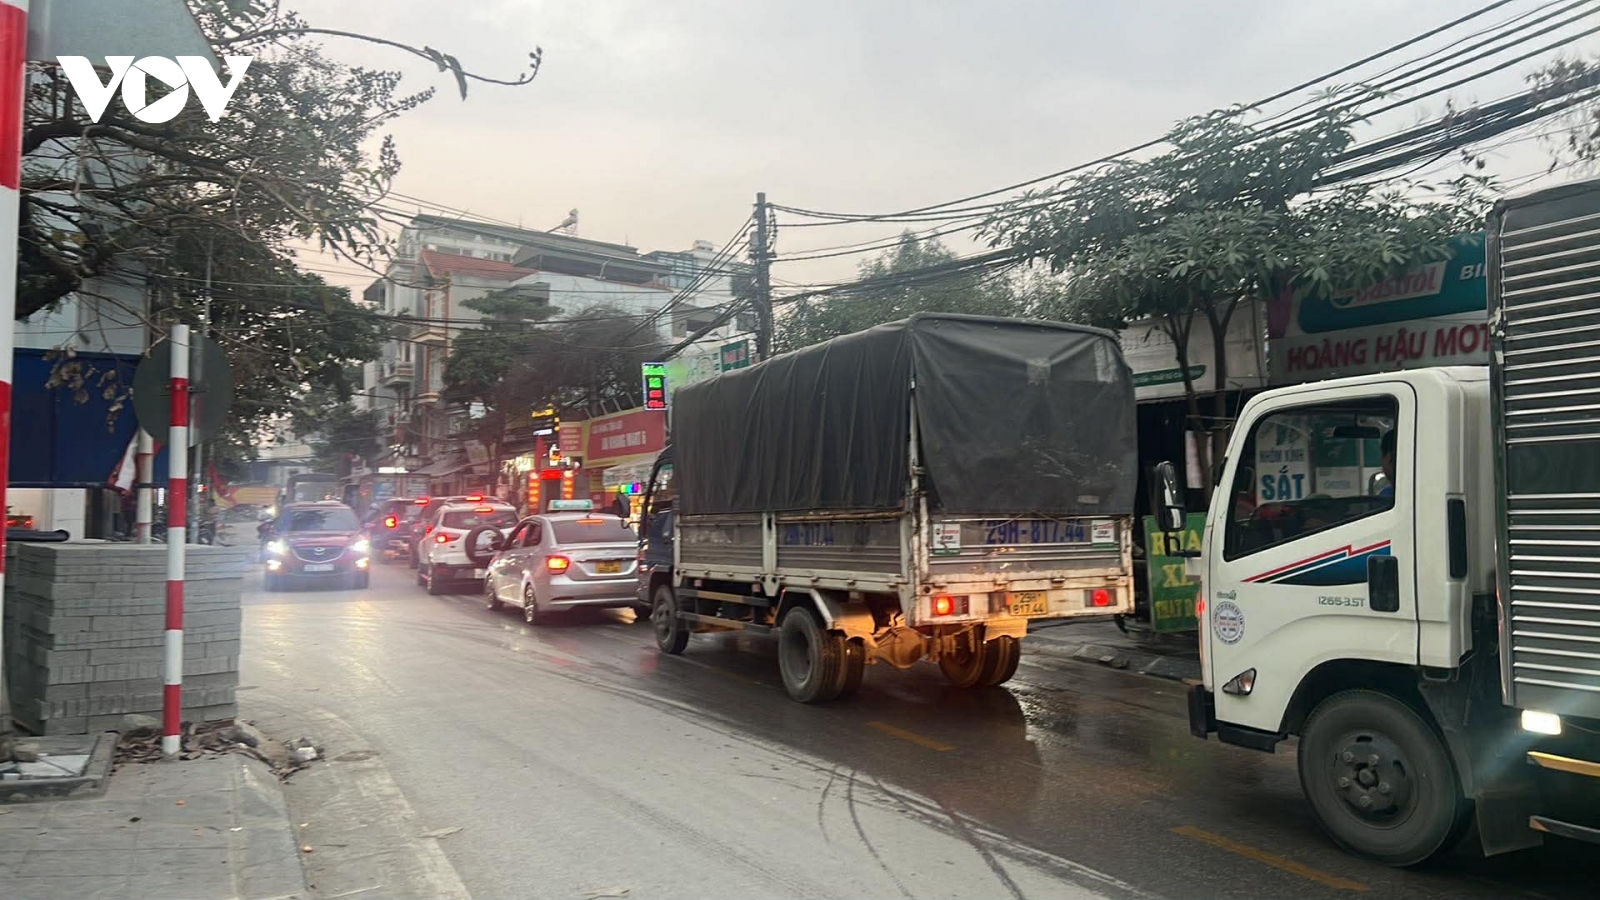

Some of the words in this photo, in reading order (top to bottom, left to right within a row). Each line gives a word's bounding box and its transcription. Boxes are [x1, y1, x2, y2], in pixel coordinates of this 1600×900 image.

[1287, 338, 1367, 372] HOÀNG
[1374, 327, 1427, 367] HẬU
[1261, 465, 1305, 500] SẮT
